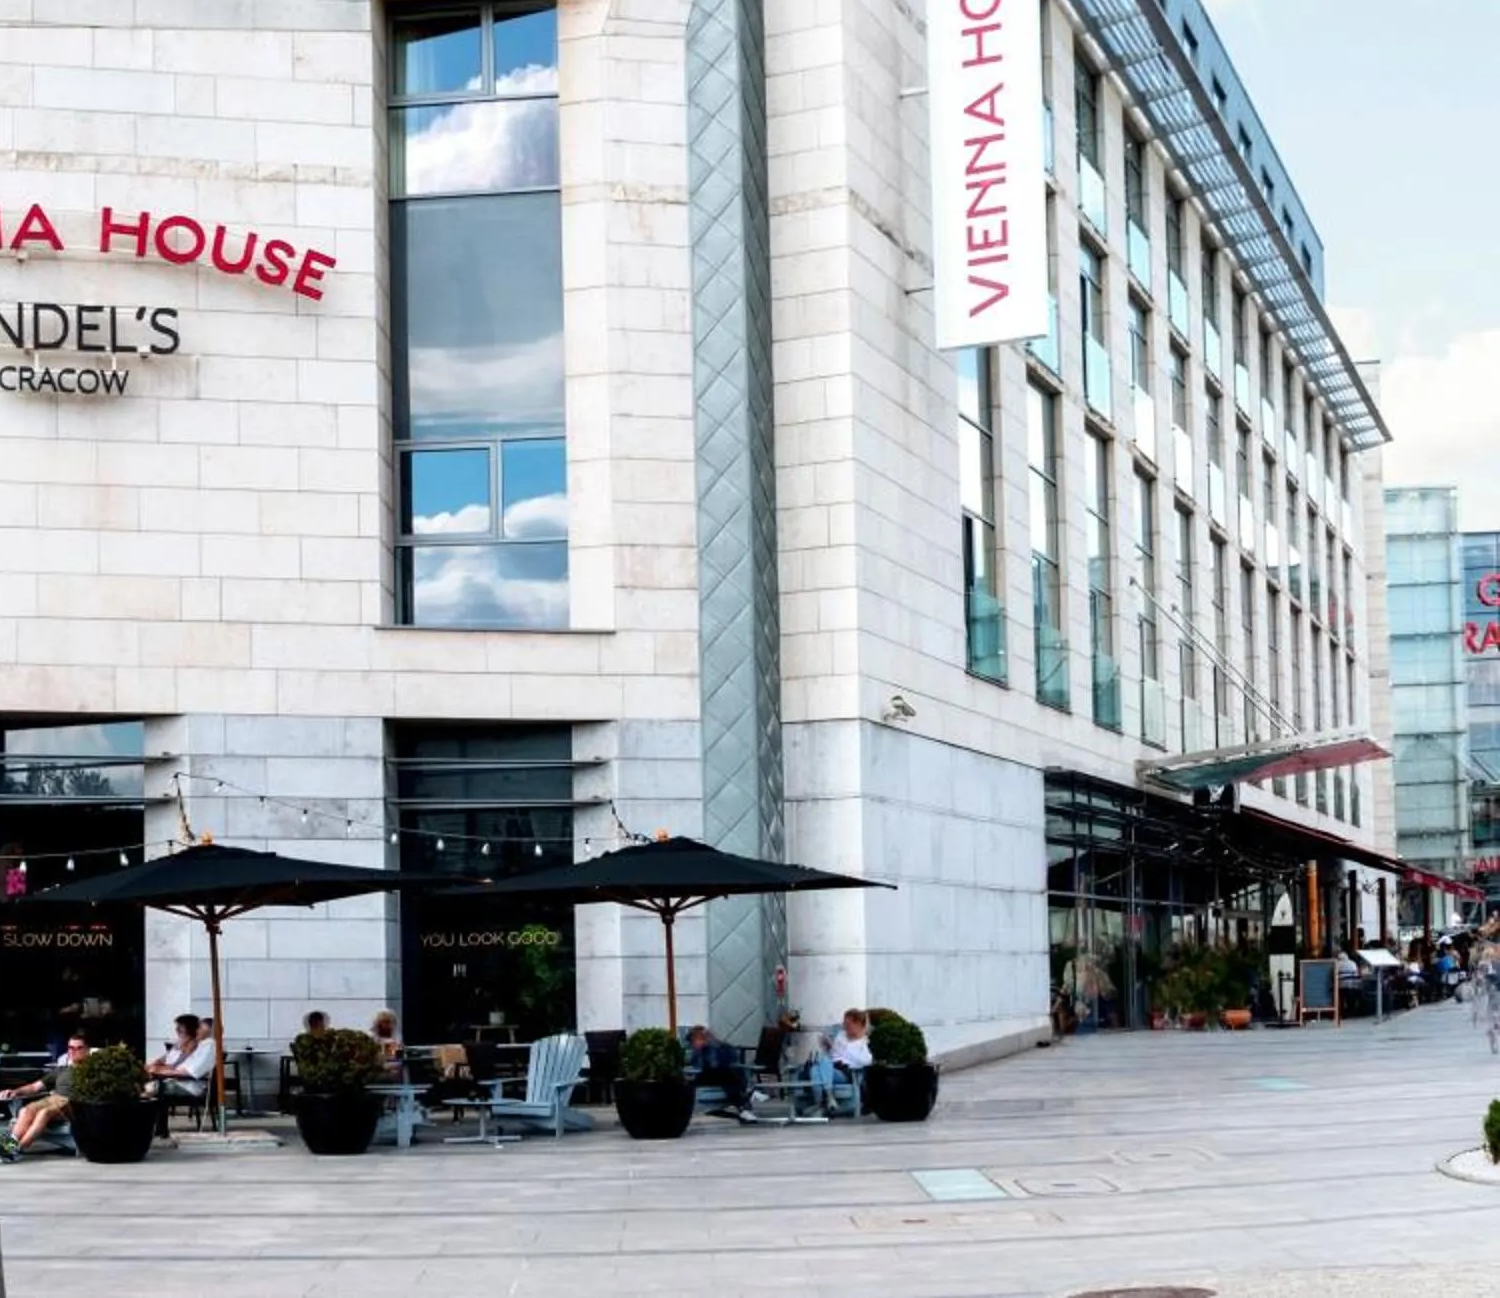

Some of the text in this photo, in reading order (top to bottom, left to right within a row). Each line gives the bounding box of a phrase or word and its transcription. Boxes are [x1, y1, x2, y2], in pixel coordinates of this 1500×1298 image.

[963, 82, 1010, 318] VIENNA
[100, 206, 338, 302] HOUSE
[3, 933, 113, 947] SLOW DOWN
[420, 931, 455, 947] YOU
[459, 931, 504, 946] LOOK
